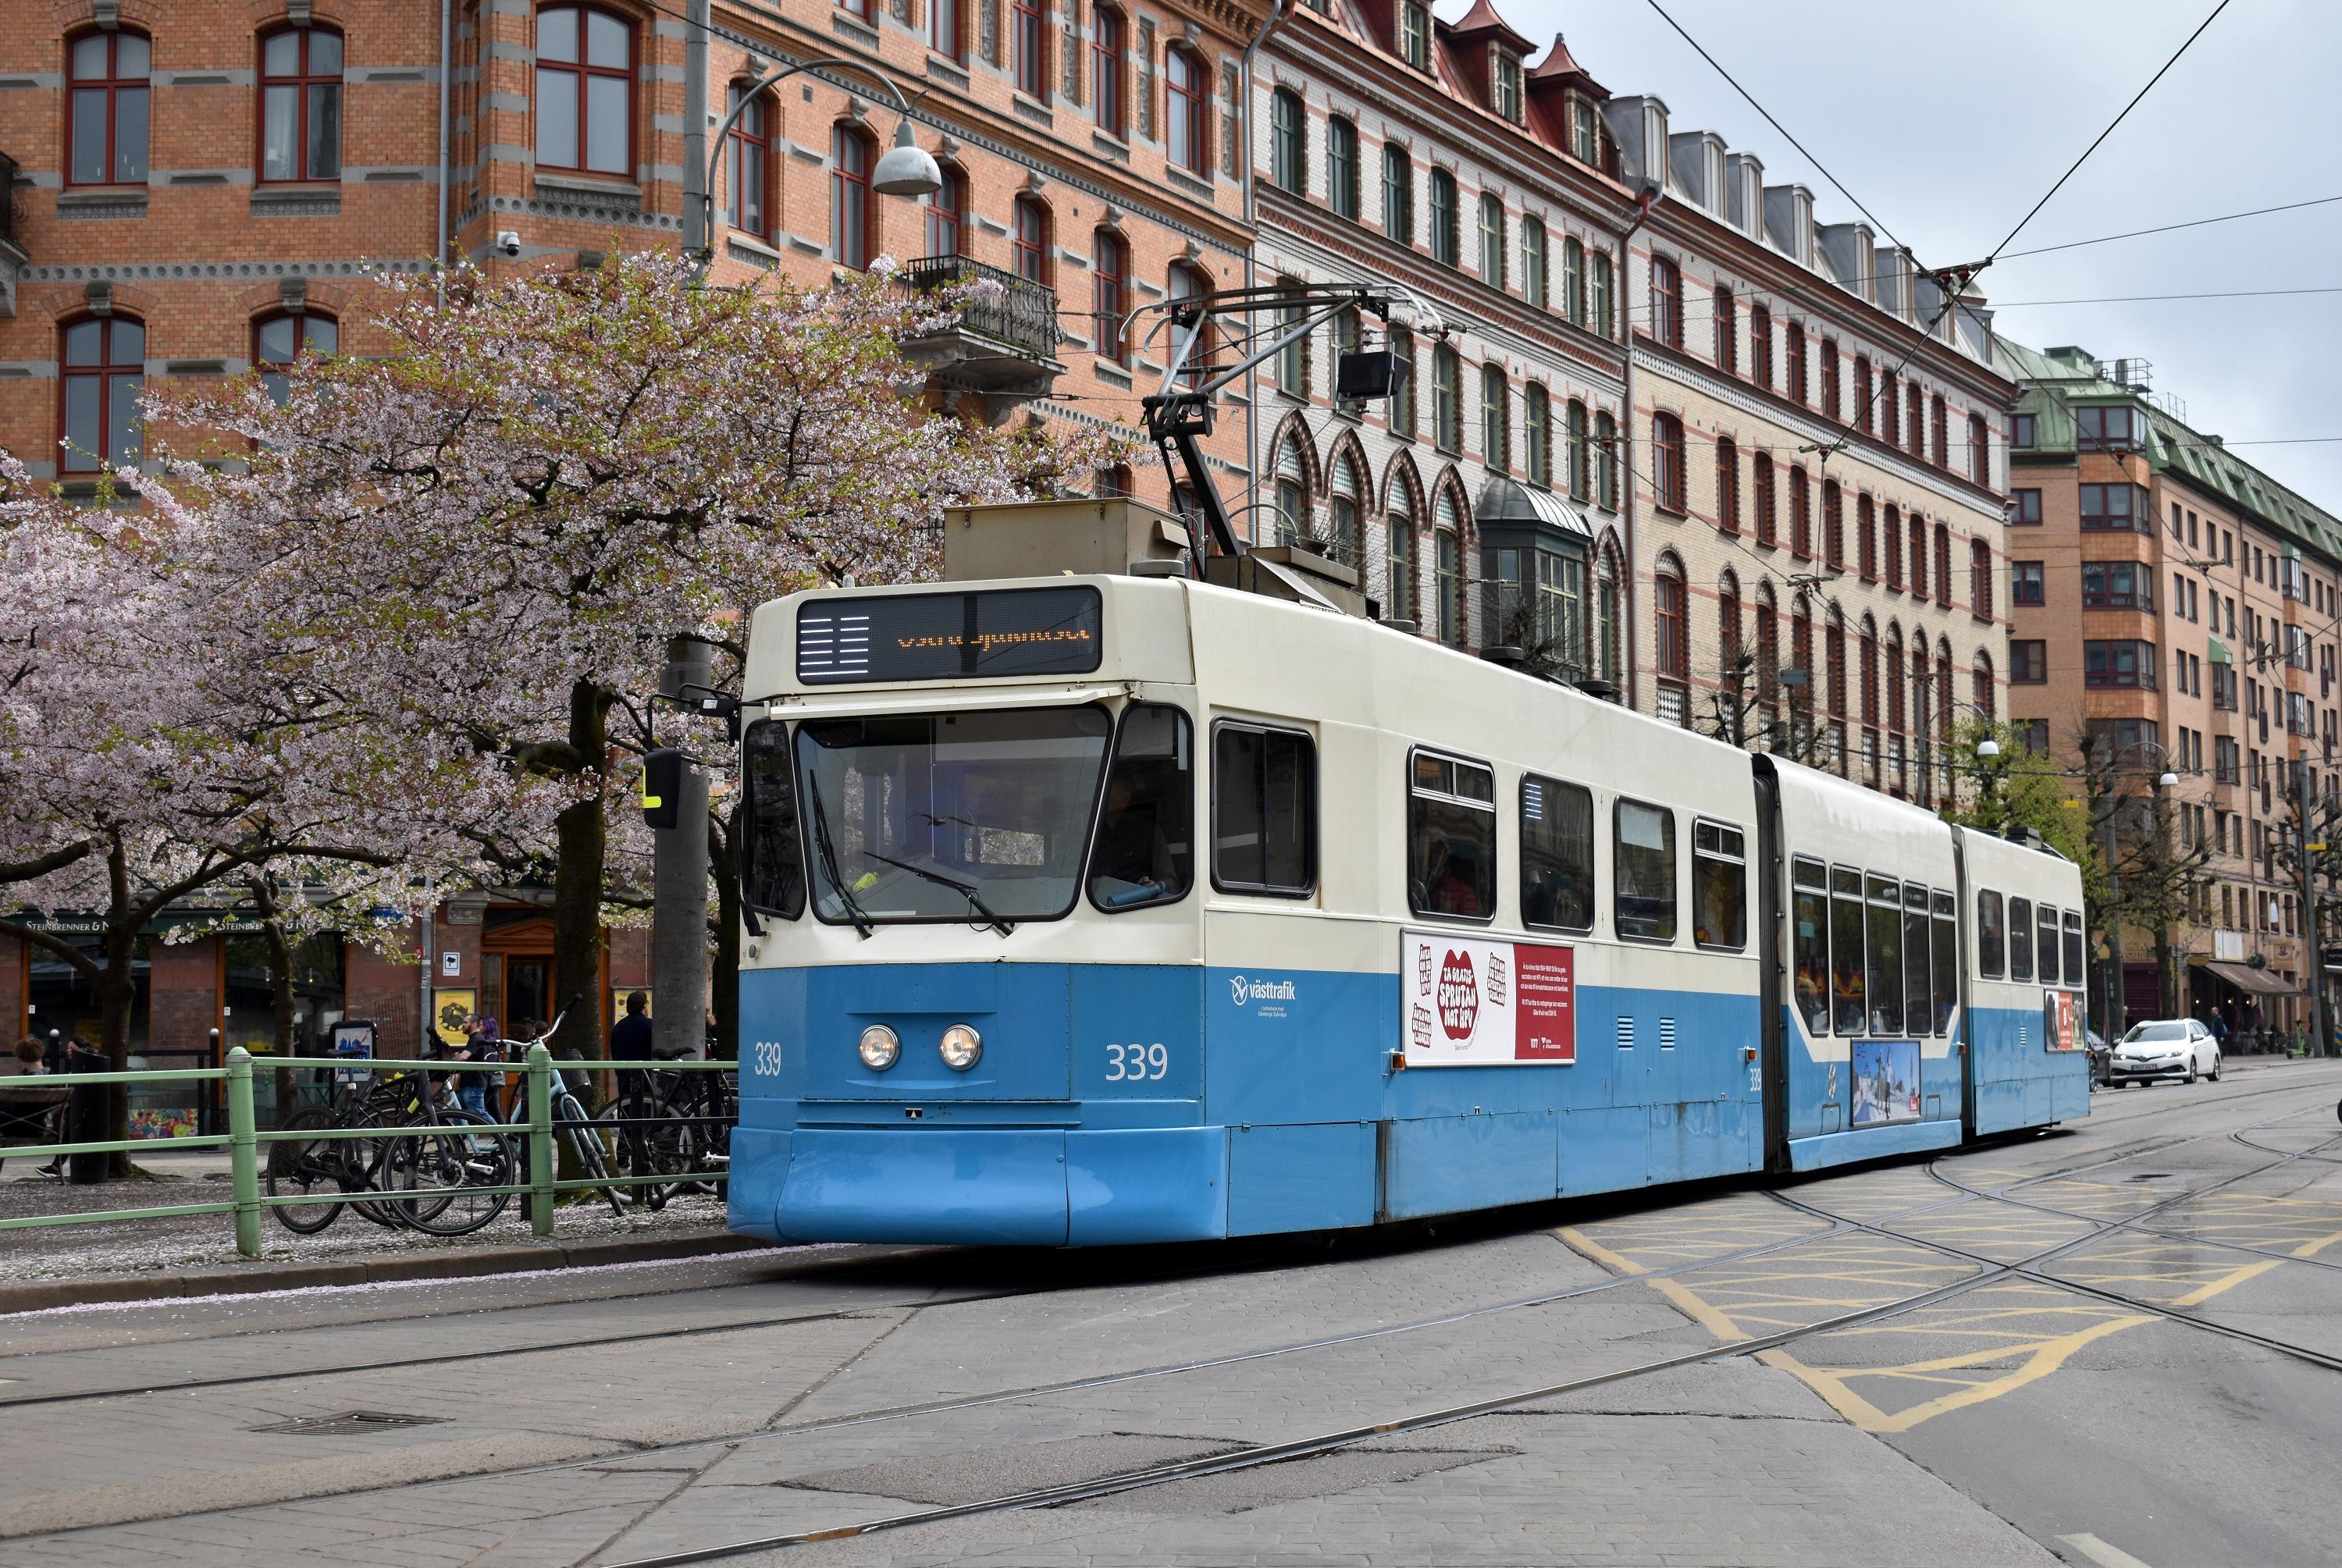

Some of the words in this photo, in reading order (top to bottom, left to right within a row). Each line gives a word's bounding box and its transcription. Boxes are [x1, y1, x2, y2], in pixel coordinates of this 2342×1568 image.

[92, 921, 100, 931] &
[1443, 967, 1451, 982] TA
[1452, 967, 1474, 984] GRATIS-
[1249, 979, 1295, 1000] västtrafik
[1439, 983, 1476, 1008] SPRUTAN
[1444, 1008, 1459, 1028] MOT
[1459, 1007, 1473, 1029] HPV
[754, 1041, 782, 1077] 339
[1105, 1043, 1169, 1081] 339
[1750, 1068, 1762, 1092] 339
